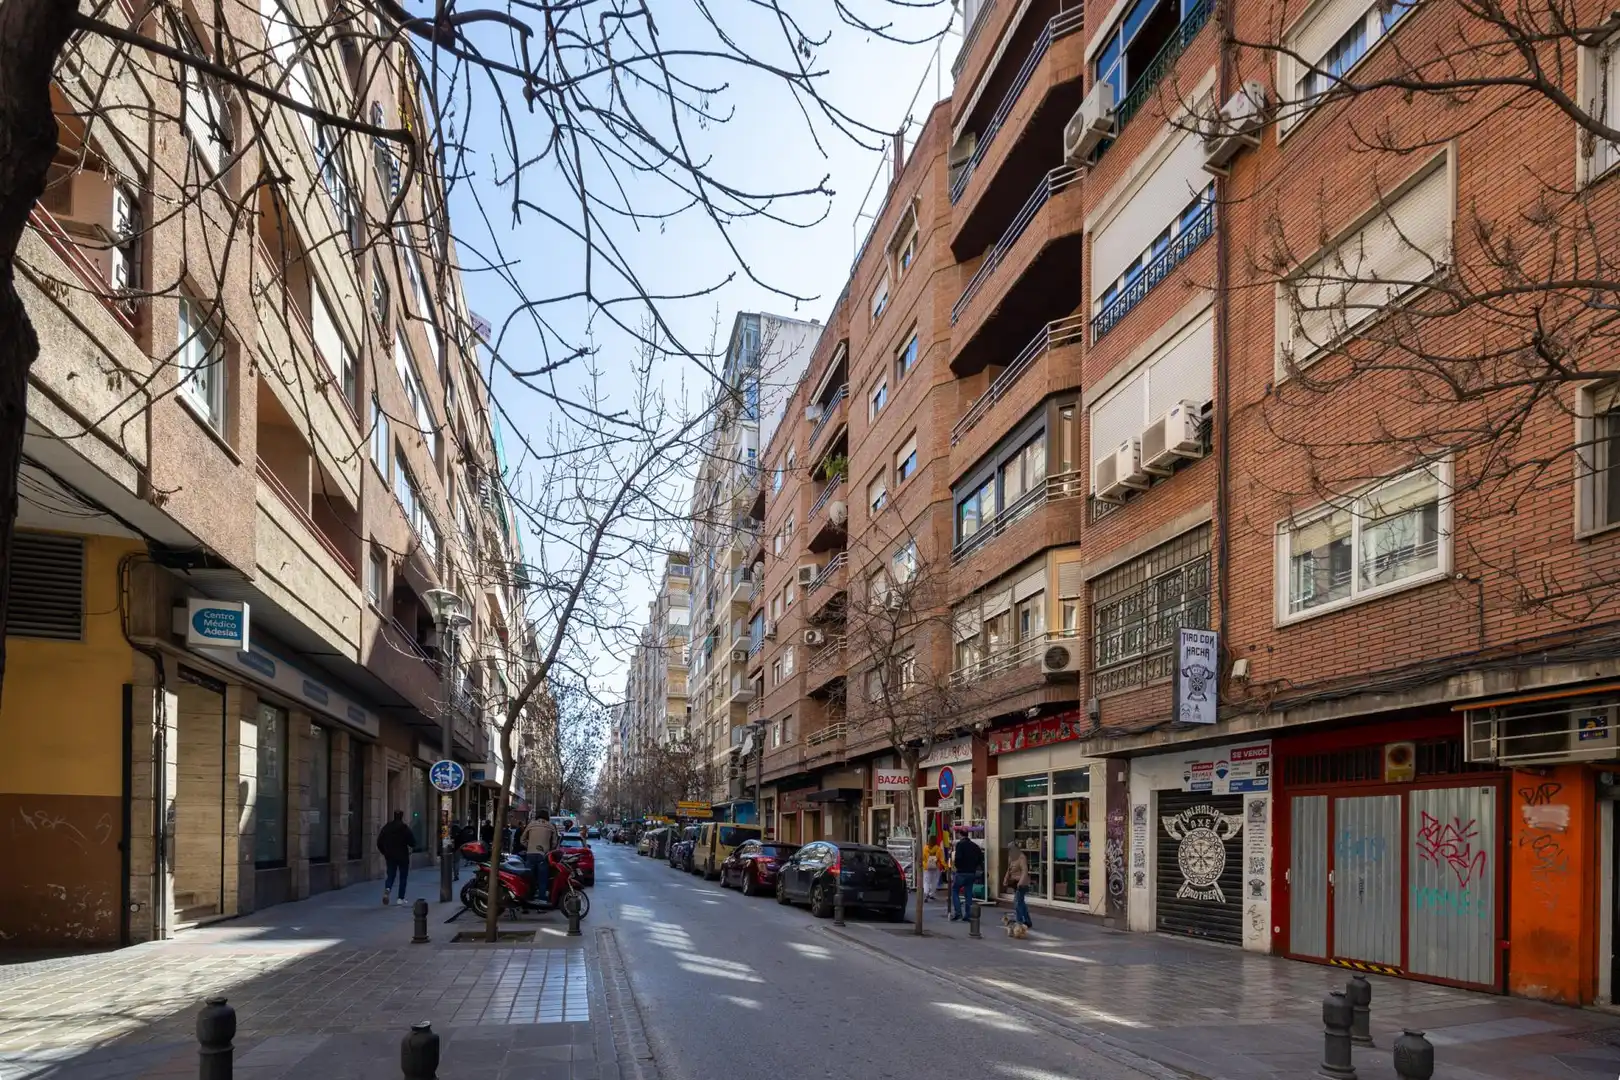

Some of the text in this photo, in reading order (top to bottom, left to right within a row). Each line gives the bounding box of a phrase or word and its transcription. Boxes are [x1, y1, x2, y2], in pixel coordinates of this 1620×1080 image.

[204, 611, 235, 620] Centro
[204, 619, 237, 629] Médico
[204, 628, 238, 637] Adeslas
[1182, 632, 1215, 648] TIRO CON
[1186, 646, 1210, 661] HACHA
[1232, 748, 1268, 759] SE VENDE
[878, 775, 910, 785] BAZAR
[1181, 805, 1220, 823] VALHALLA
[1190, 818, 1211, 828] AXE
[1181, 886, 1221, 903] BROTHER
